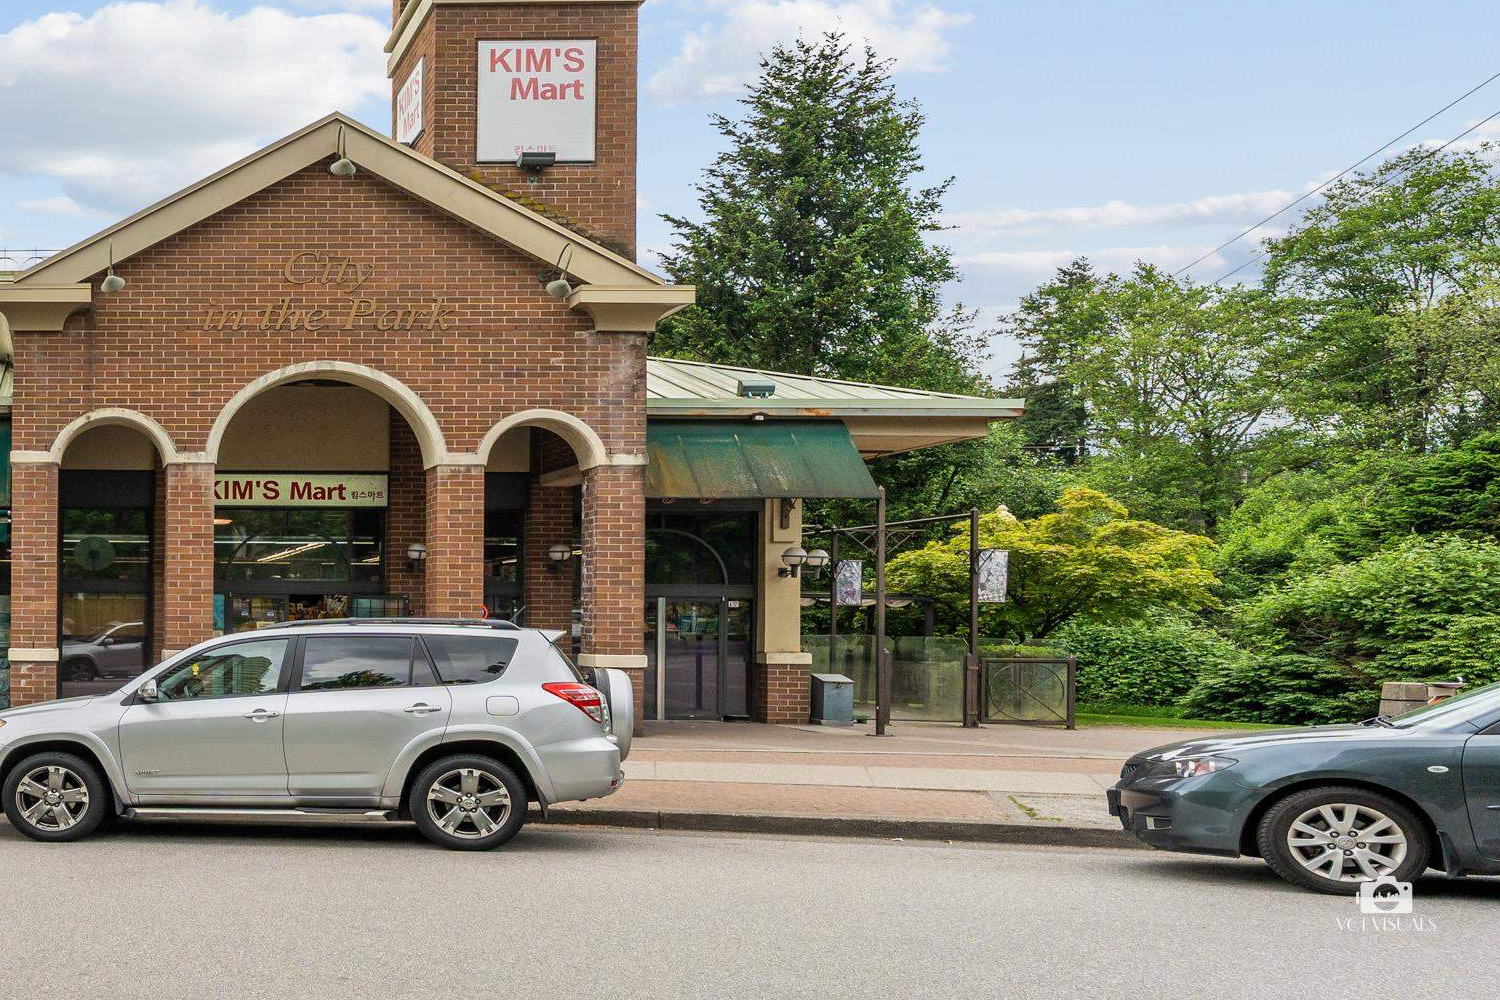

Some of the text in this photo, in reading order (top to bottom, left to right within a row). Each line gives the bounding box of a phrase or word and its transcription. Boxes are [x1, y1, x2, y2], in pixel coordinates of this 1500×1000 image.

[490, 48, 585, 73] KIM'S
[510, 77, 585, 100] Mart
[284, 250, 375, 293] City
[203, 297, 456, 331] in the Park
[290, 481, 347, 500] Mart
